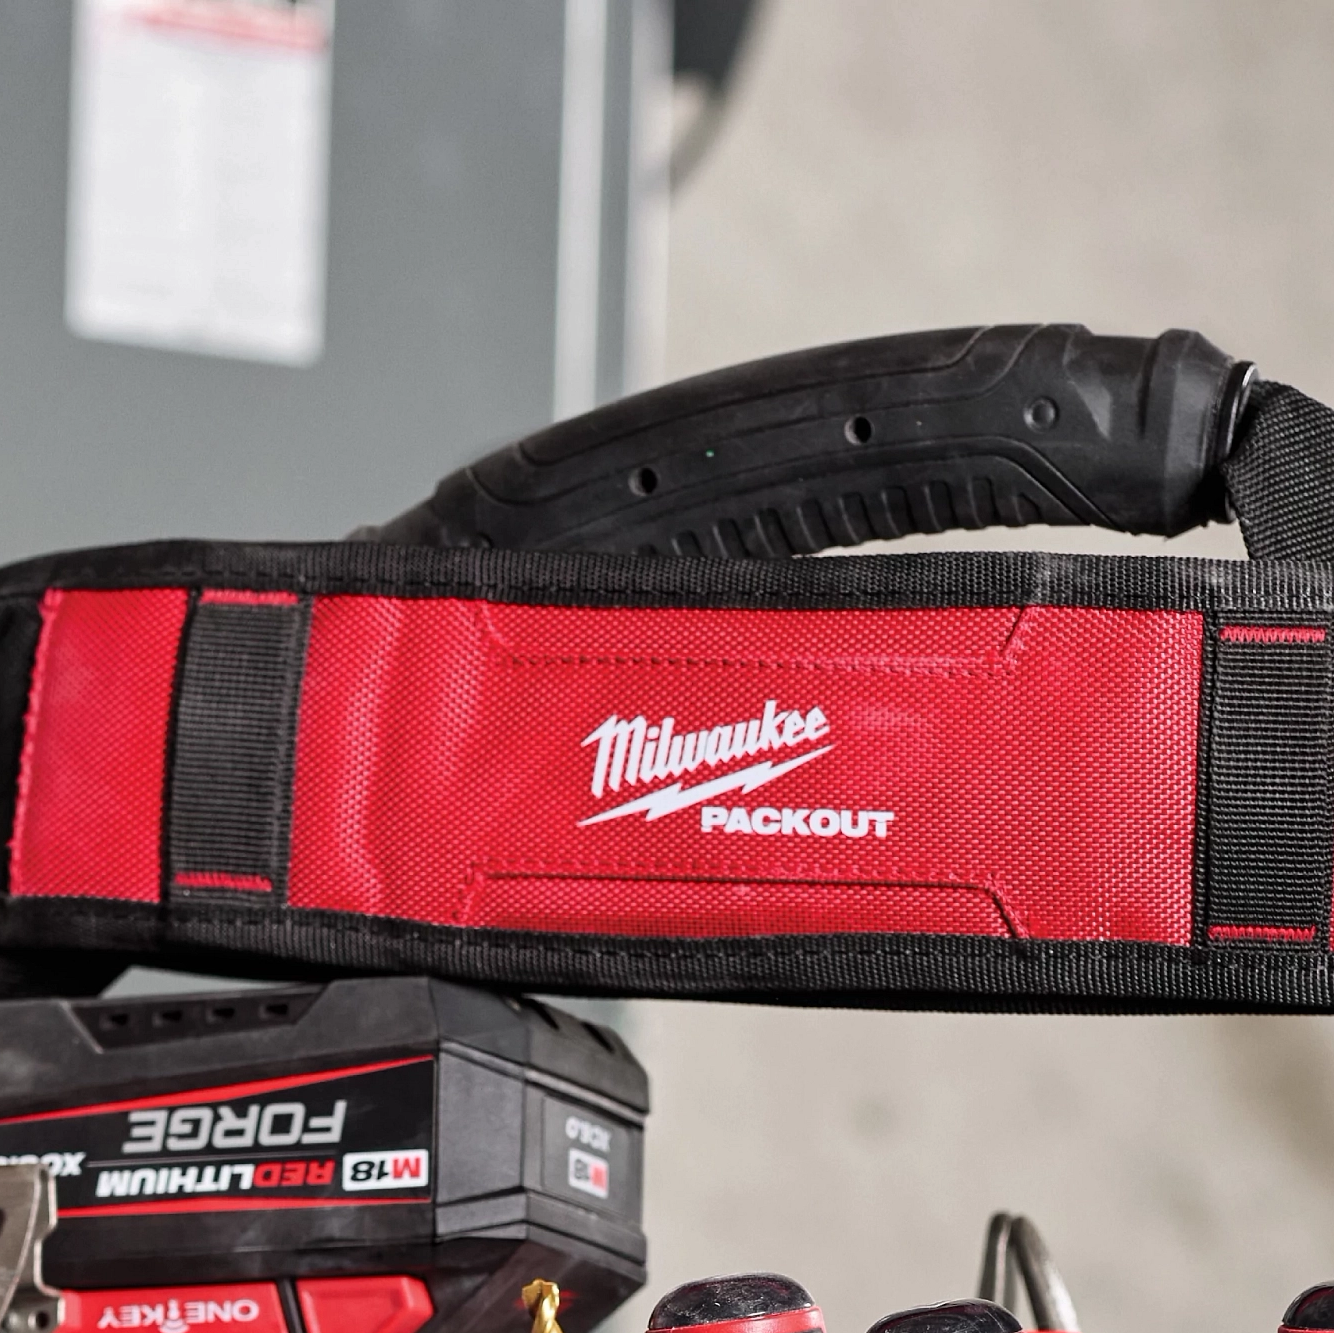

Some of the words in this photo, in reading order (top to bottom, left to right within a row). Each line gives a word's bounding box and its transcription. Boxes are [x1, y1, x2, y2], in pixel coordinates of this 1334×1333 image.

[581, 700, 830, 798] Milwaukee
[701, 807, 894, 838] PACKOUT
[123, 1101, 347, 1153] FORGE
[96, 1160, 336, 1198] REDLITHIUM
[349, 1156, 422, 1182] M18
